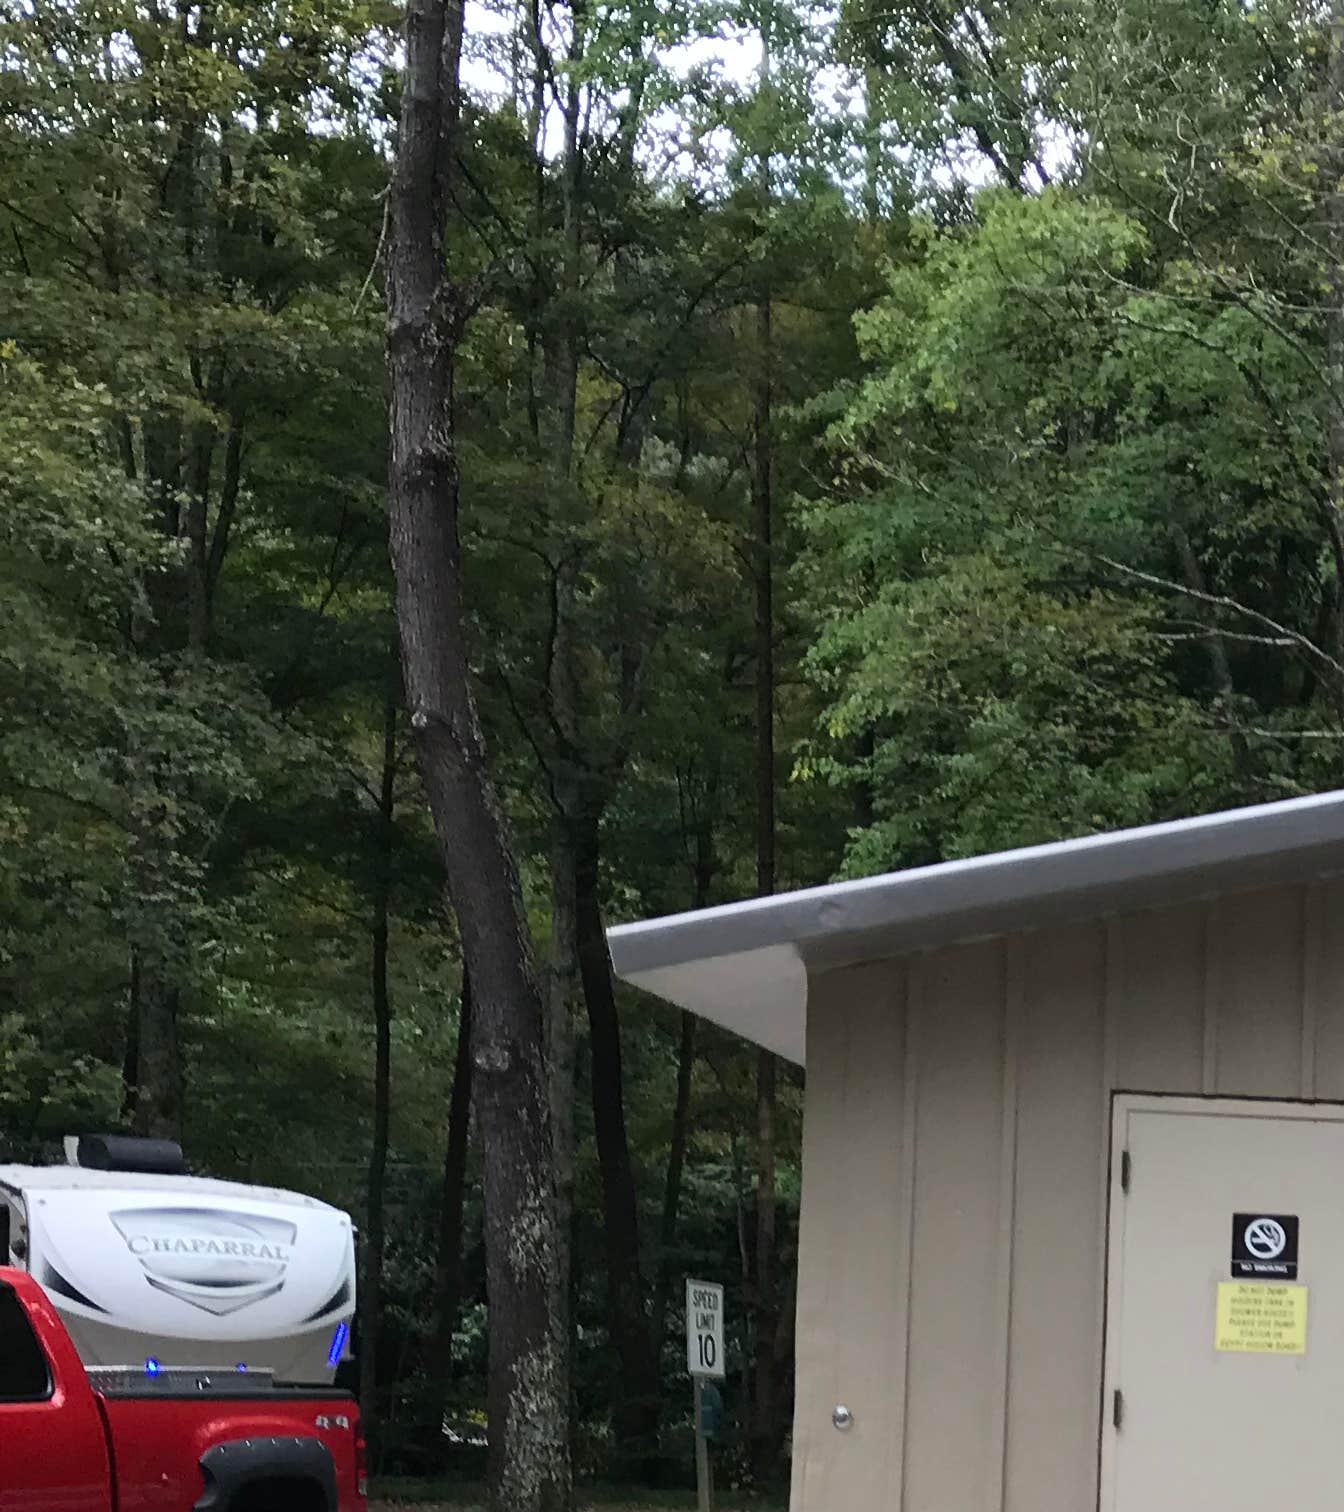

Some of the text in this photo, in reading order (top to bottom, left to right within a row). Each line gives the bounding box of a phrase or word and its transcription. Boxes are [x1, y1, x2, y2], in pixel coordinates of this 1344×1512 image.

[127, 1235, 290, 1263] CHAPARRAL
[693, 1288, 719, 1310] SPEED
[696, 1312, 715, 1330] LIMIT
[698, 1333, 716, 1369] 10
[315, 1415, 349, 1429] 44
